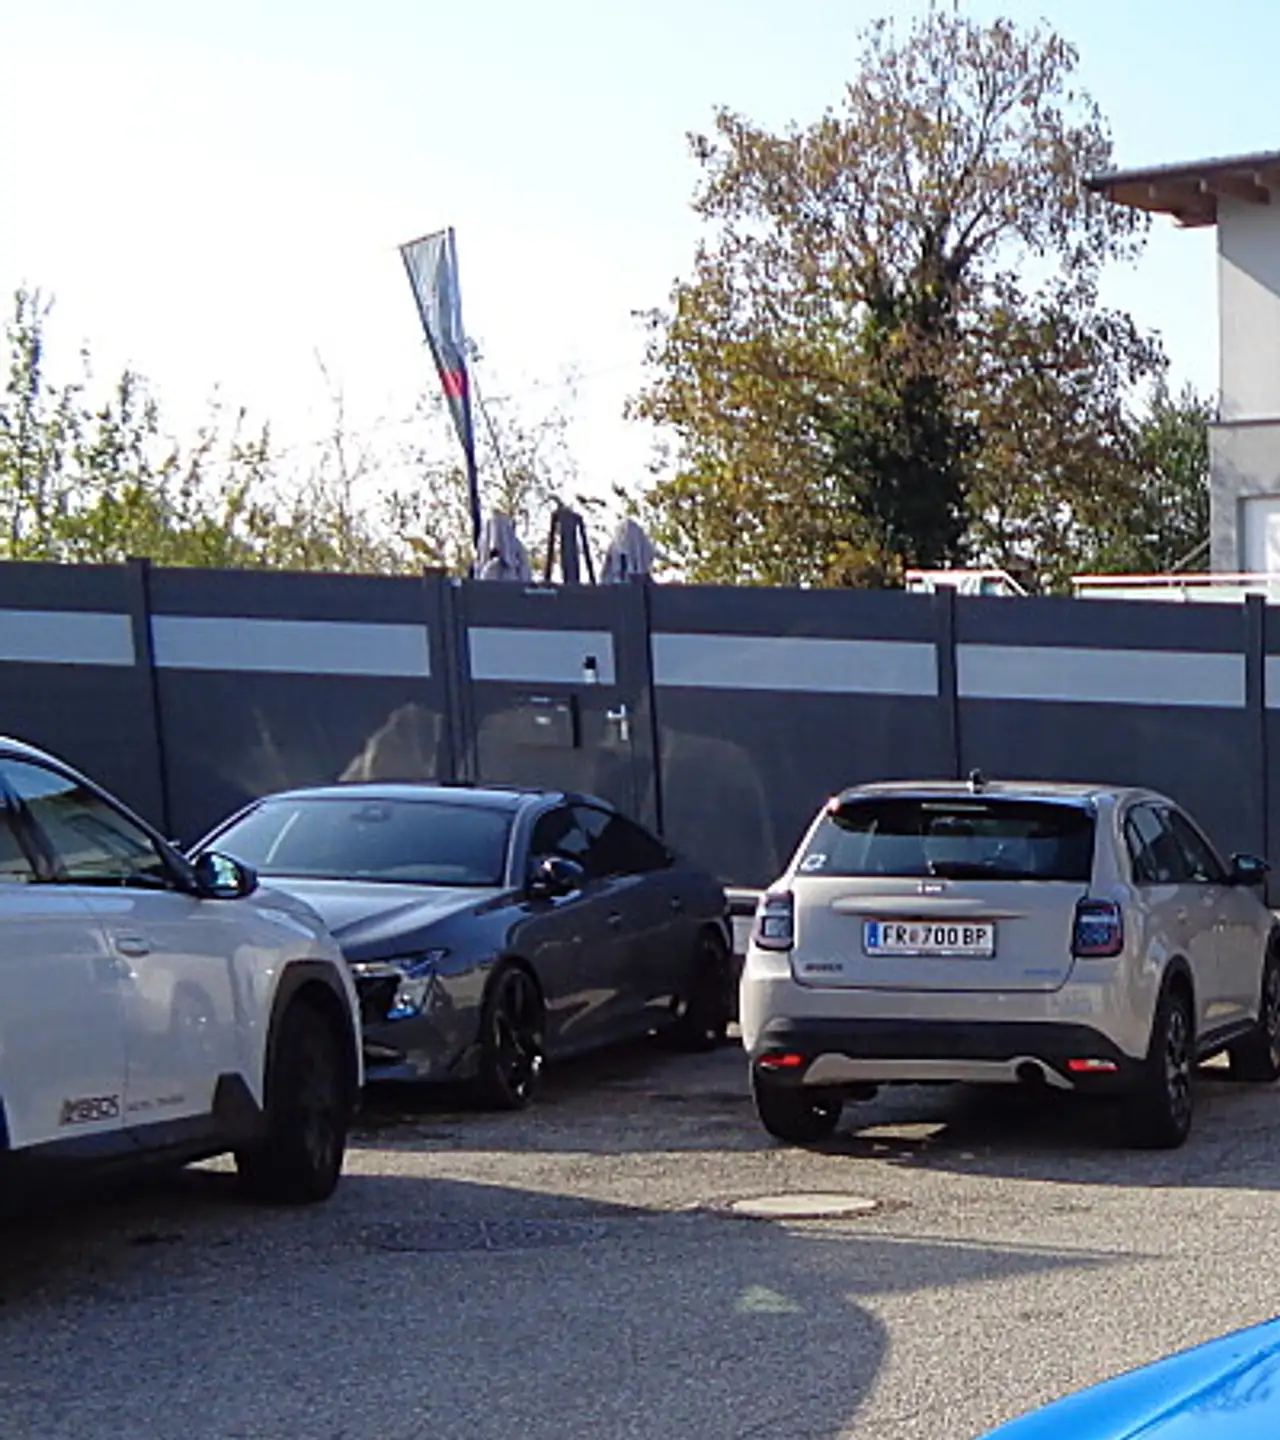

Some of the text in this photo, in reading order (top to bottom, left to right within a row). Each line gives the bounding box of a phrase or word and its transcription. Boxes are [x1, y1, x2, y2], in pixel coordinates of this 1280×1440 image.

[883, 924, 987, 946] FR 700 BP
